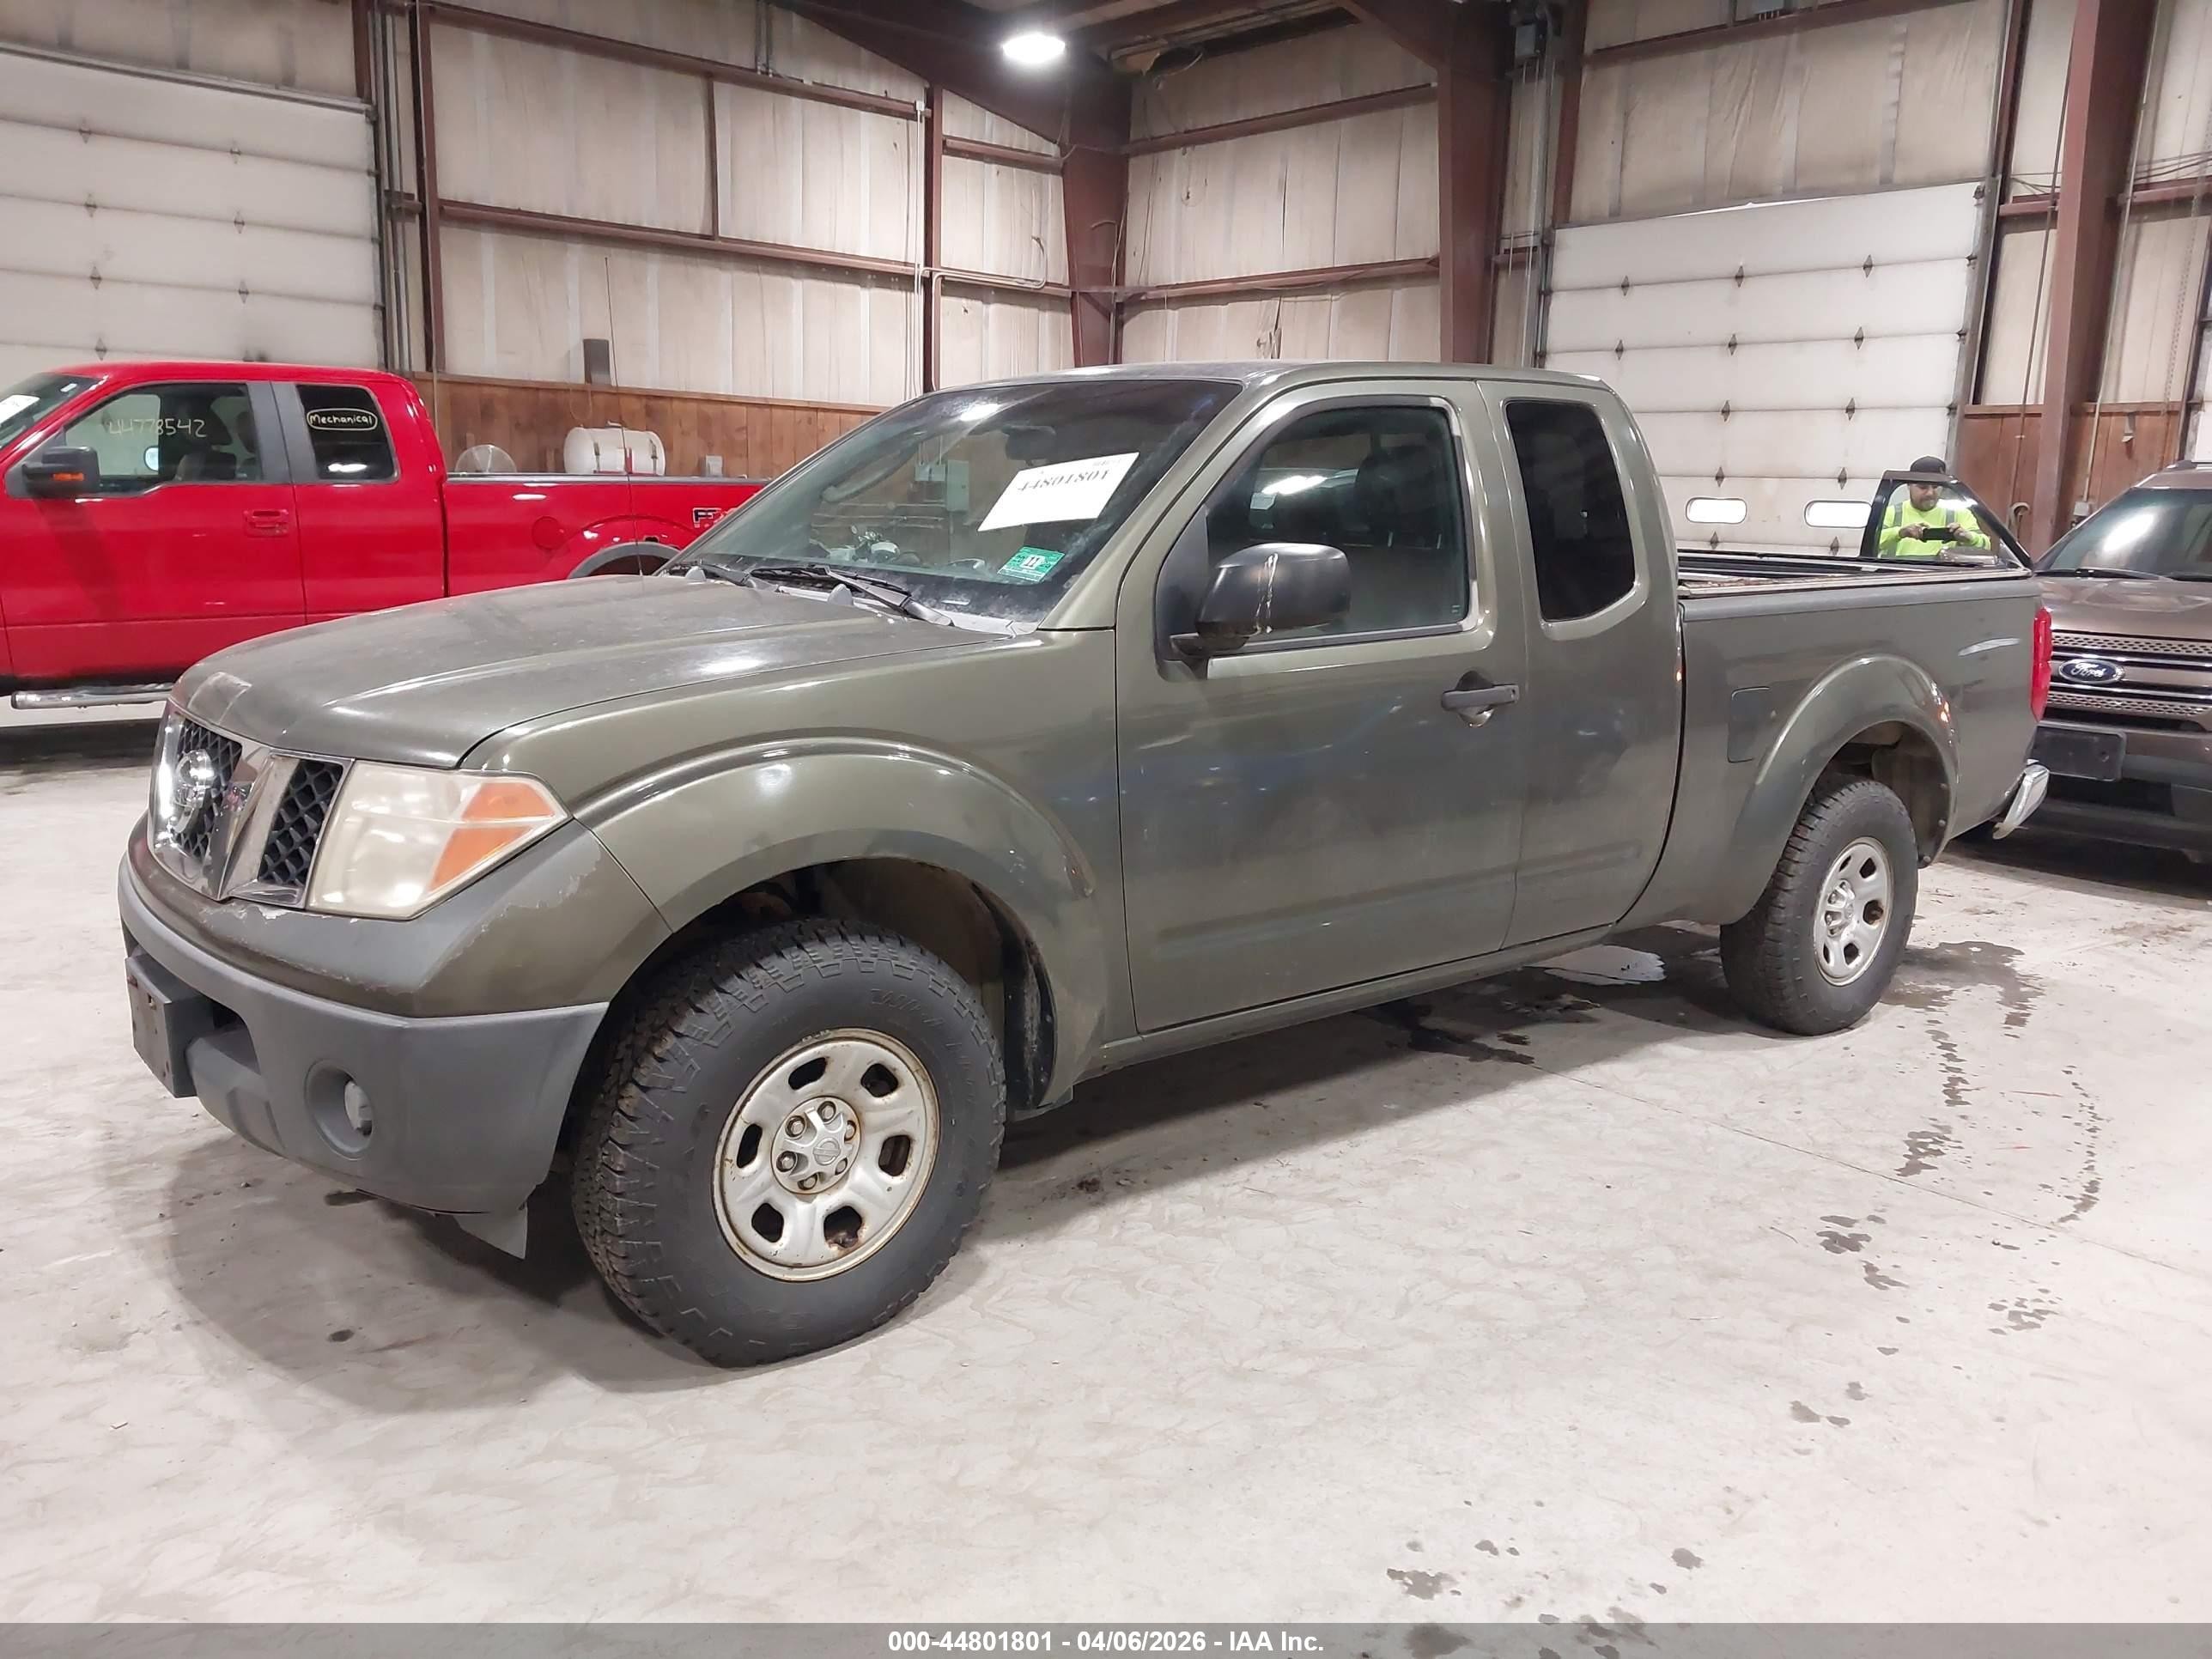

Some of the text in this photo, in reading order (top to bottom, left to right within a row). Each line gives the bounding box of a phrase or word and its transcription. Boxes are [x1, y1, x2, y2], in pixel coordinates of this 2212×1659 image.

[109, 418, 207, 437] 44778542
[309, 413, 373, 425] Mechanical
[1017, 470, 1109, 491] 44801801
[2070, 661, 2107, 678] Ford
